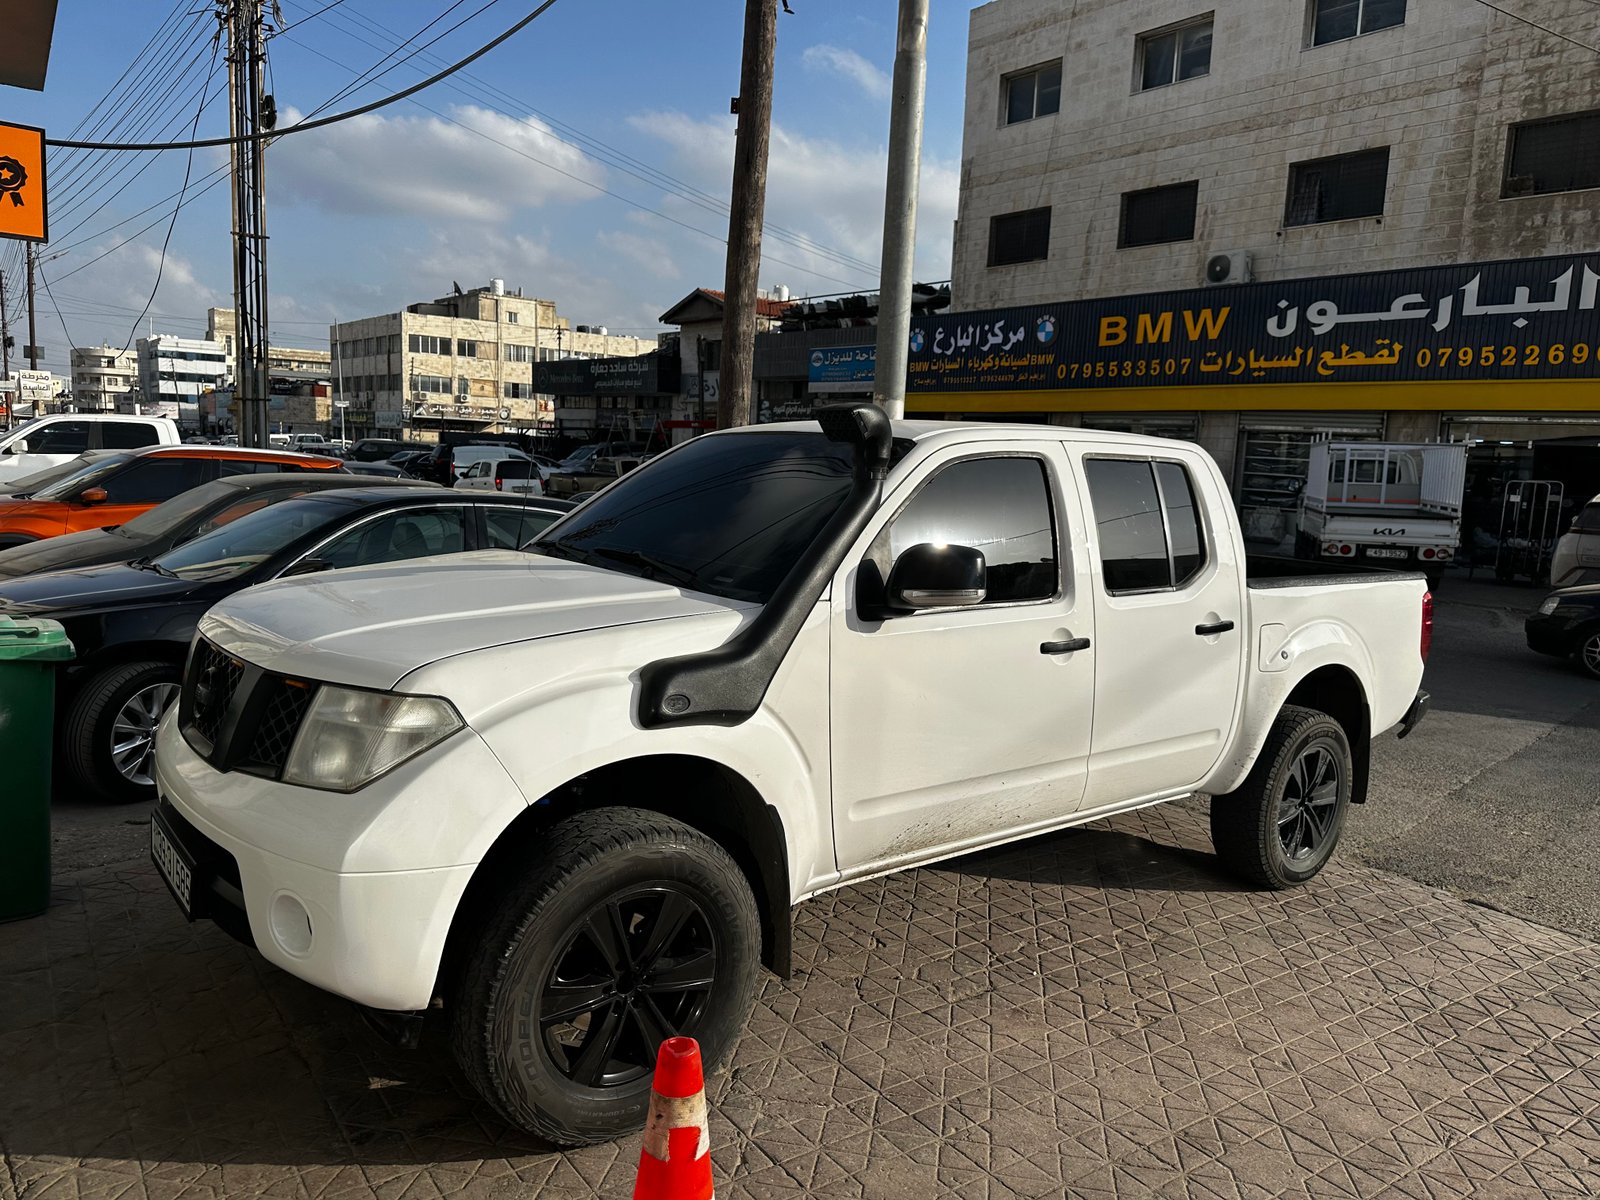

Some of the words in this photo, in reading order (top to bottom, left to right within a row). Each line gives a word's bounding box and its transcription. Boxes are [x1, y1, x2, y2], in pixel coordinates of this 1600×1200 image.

[980, 319, 1026, 351] مركز
[1098, 306, 1231, 347] BMW
[933, 324, 980, 355] البارع
[627, 358, 649, 375] شركة
[909, 361, 930, 373] BMW
[931, 356, 965, 374] السيارات
[1030, 353, 1056, 366] BMW
[1199, 345, 1314, 377] السيارات
[1316, 338, 1403, 376] لقطع
[1416, 342, 1600, 369] 07952269
[1057, 357, 1192, 380] 0795533507
[1373, 527, 1406, 536] KIA
